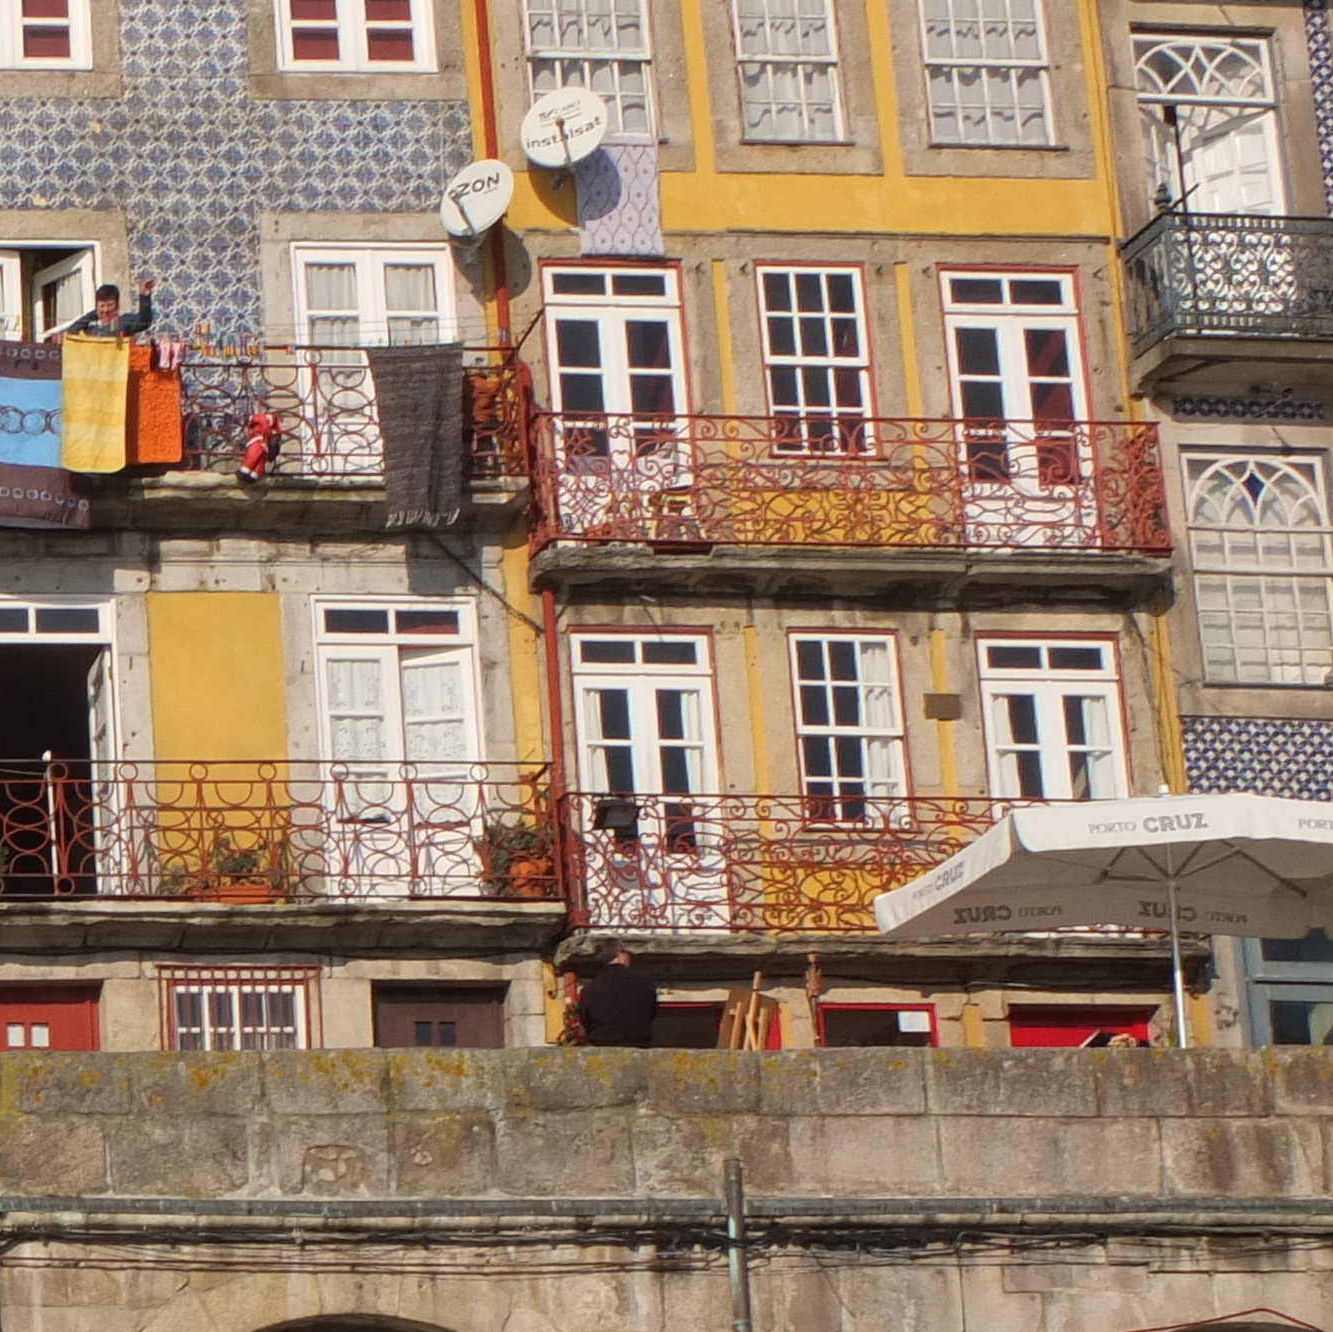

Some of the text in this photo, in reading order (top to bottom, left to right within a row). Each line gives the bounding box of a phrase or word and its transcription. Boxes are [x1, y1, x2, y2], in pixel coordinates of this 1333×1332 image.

[525, 115, 602, 149] instlsat
[456, 171, 500, 197] ZON
[1088, 812, 1209, 834] PORTO CRUZ
